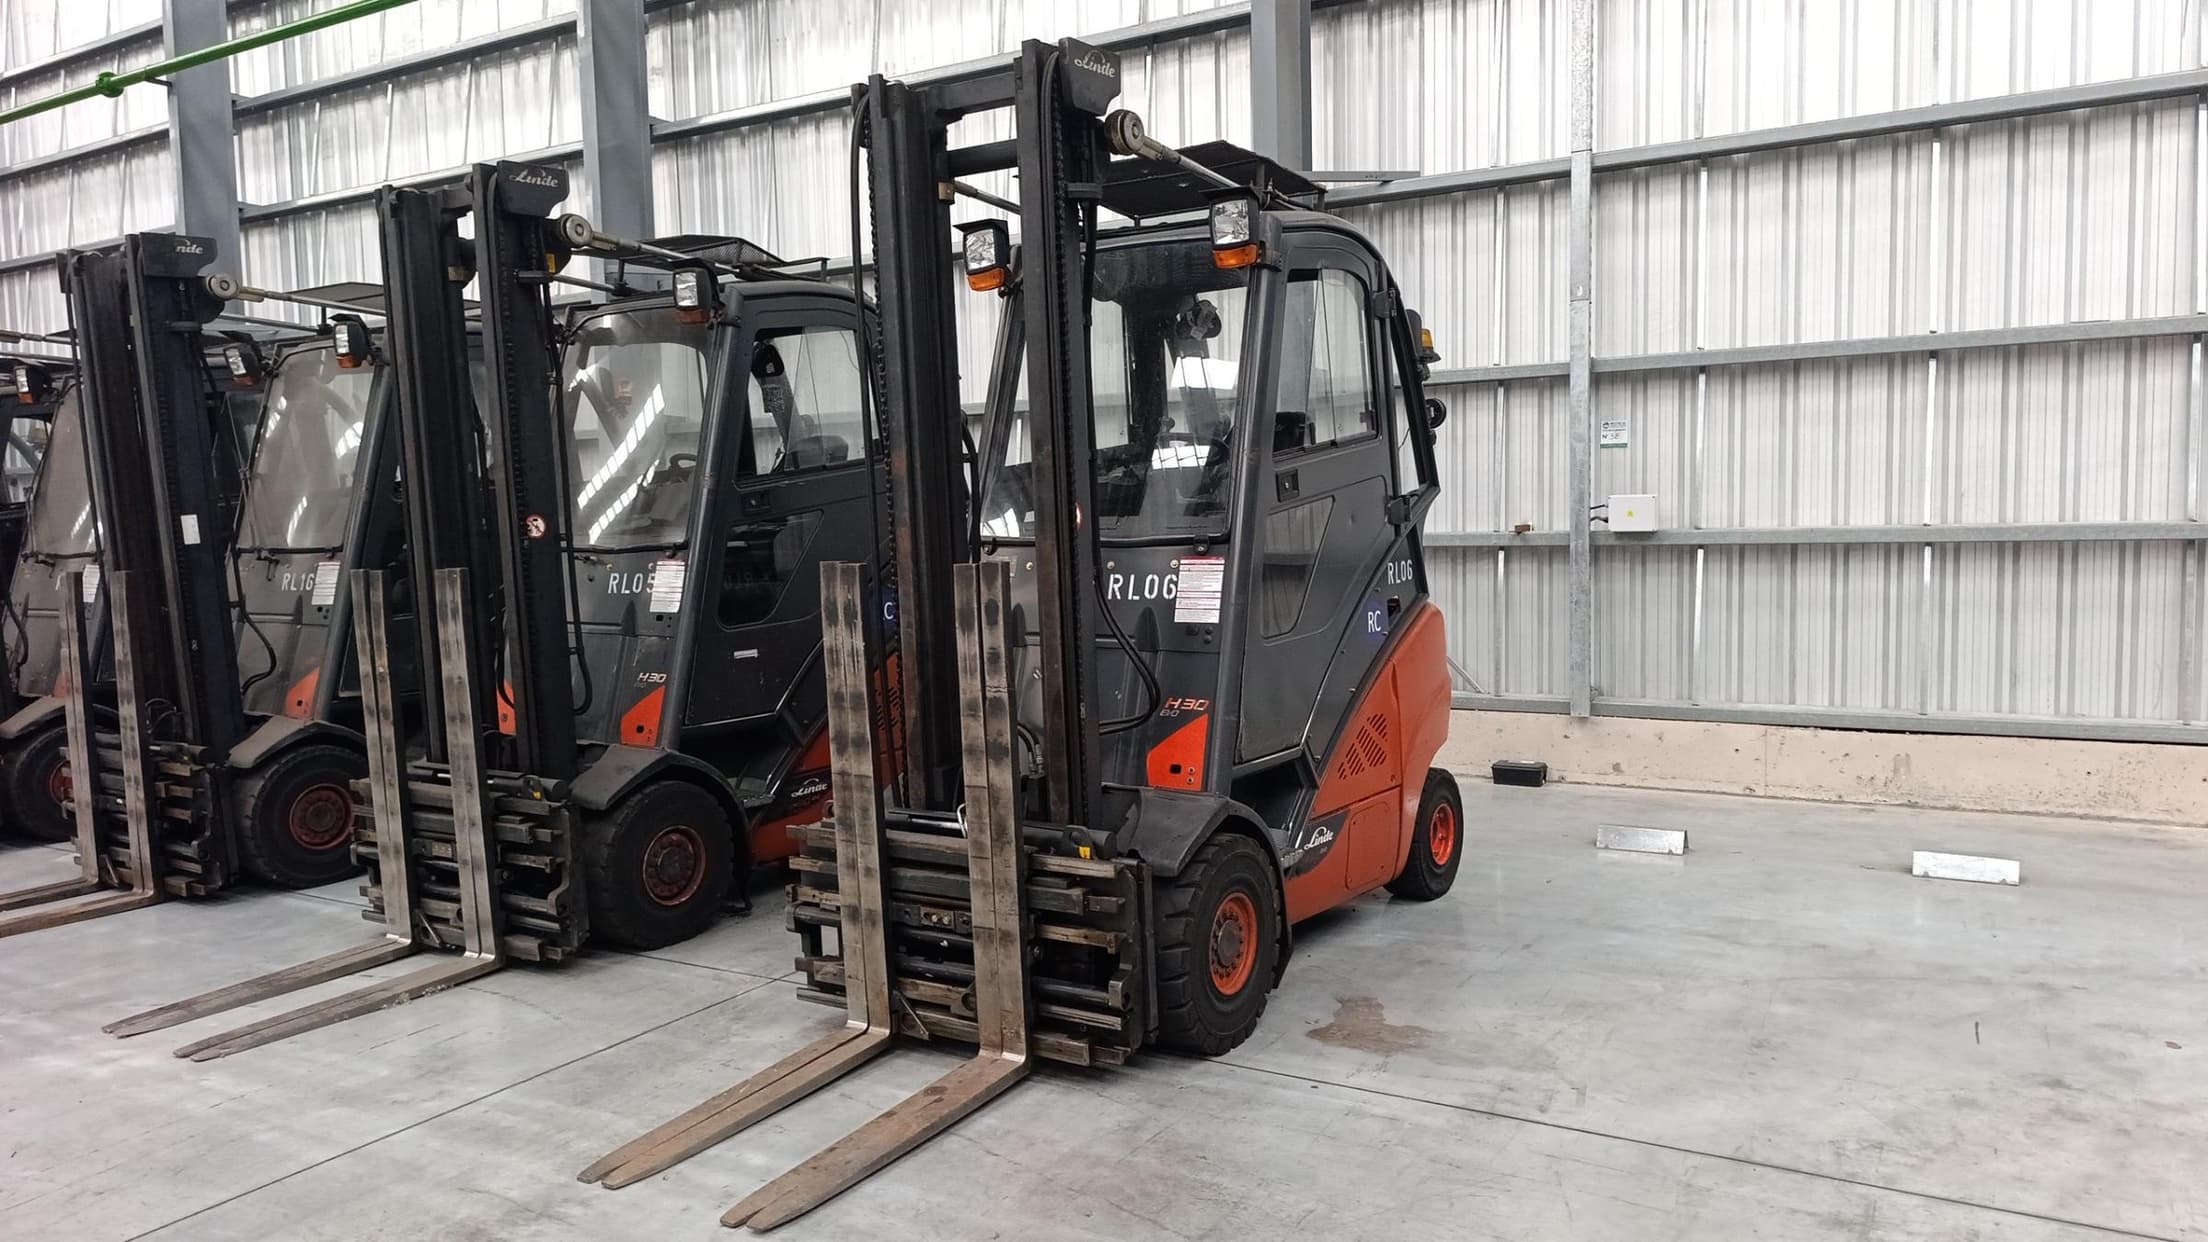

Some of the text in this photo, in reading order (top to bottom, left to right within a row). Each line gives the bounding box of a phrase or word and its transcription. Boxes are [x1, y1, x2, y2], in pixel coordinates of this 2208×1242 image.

[1074, 50, 1115, 78] Linde
[509, 168, 559, 188] Linde
[1367, 609, 1382, 633] RC
[637, 672, 667, 683] H30
[1164, 697, 1210, 711] H30
[1303, 826, 1335, 850] Linde
